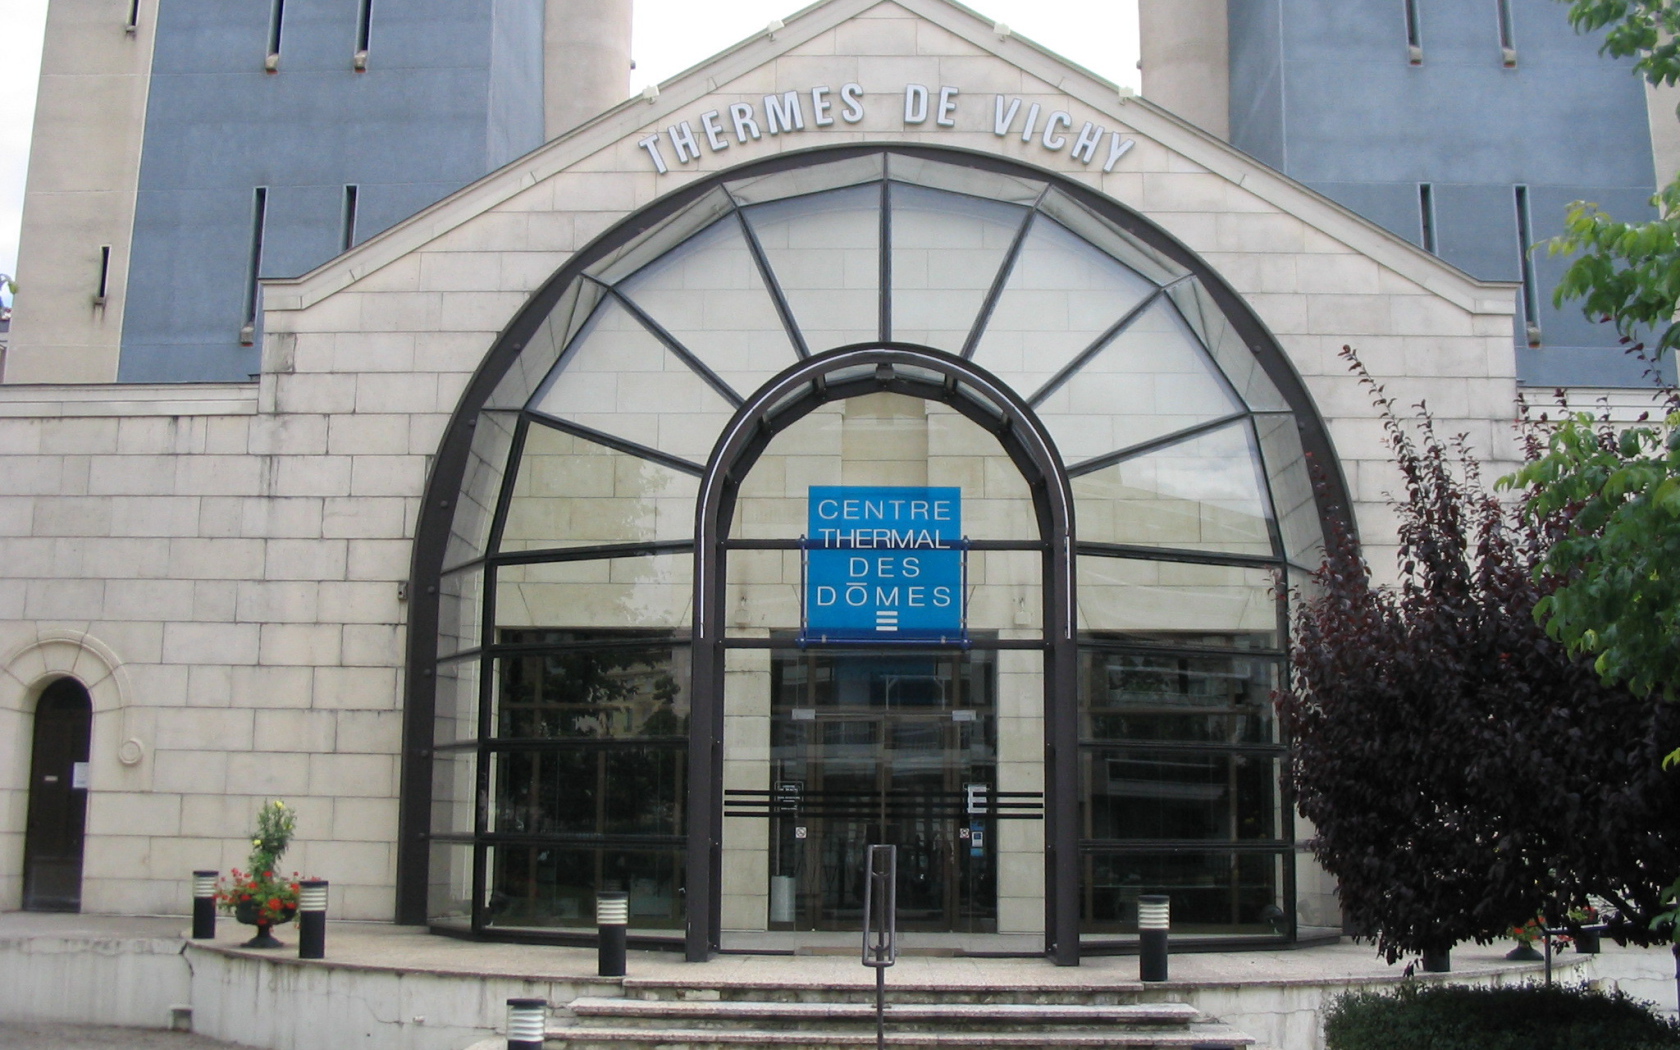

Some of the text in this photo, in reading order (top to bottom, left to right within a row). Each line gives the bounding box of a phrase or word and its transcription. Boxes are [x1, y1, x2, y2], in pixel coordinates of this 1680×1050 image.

[638, 83, 1136, 174] THERMES DE VICHY
[818, 499, 951, 521] CENTRE
[818, 528, 951, 549] THERMAL
[849, 557, 920, 578] DES
